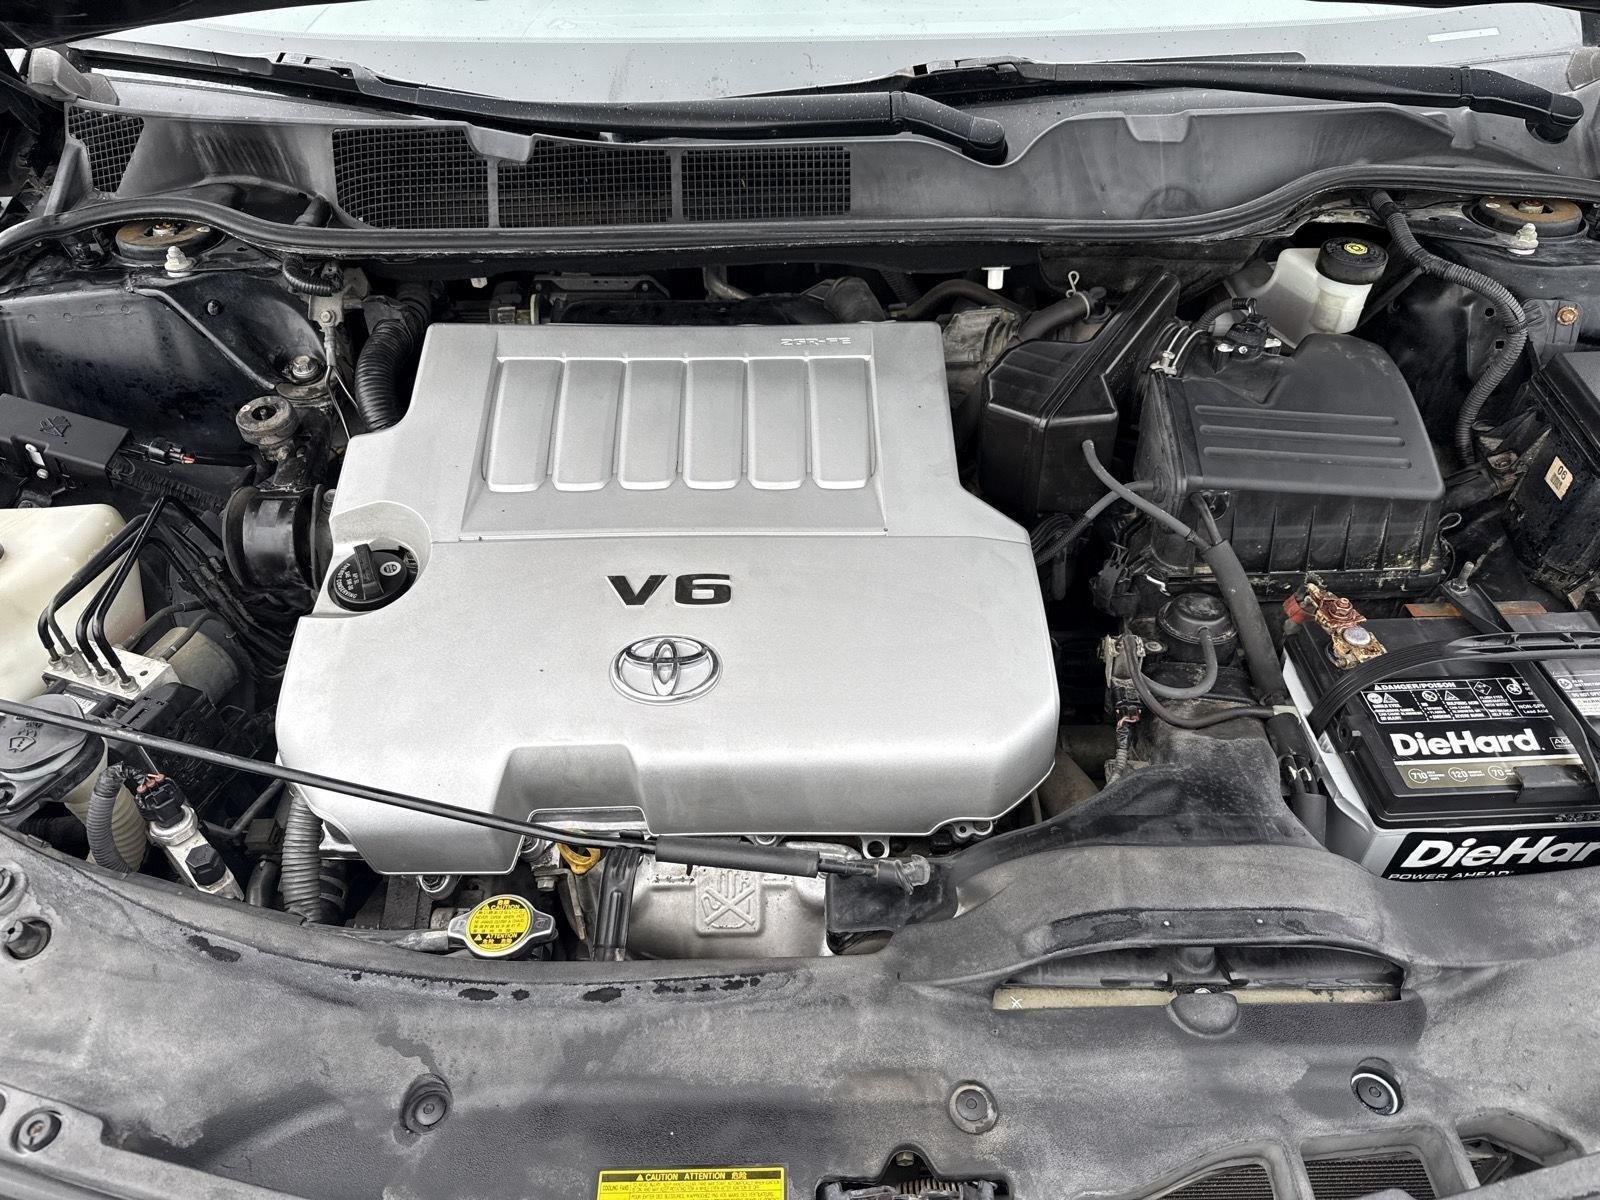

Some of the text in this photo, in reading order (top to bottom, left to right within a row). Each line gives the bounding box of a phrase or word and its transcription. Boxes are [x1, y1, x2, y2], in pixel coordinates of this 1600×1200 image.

[604, 574, 732, 606] V6
[1381, 682, 1457, 690] DANGER/POISON
[1410, 772, 1428, 780] 710
[1450, 770, 1468, 779] 120
[1490, 769, 1505, 777] 70
[1400, 836, 1600, 868] DieHar
[645, 1172, 726, 1181] CAUTION ATTENTION
